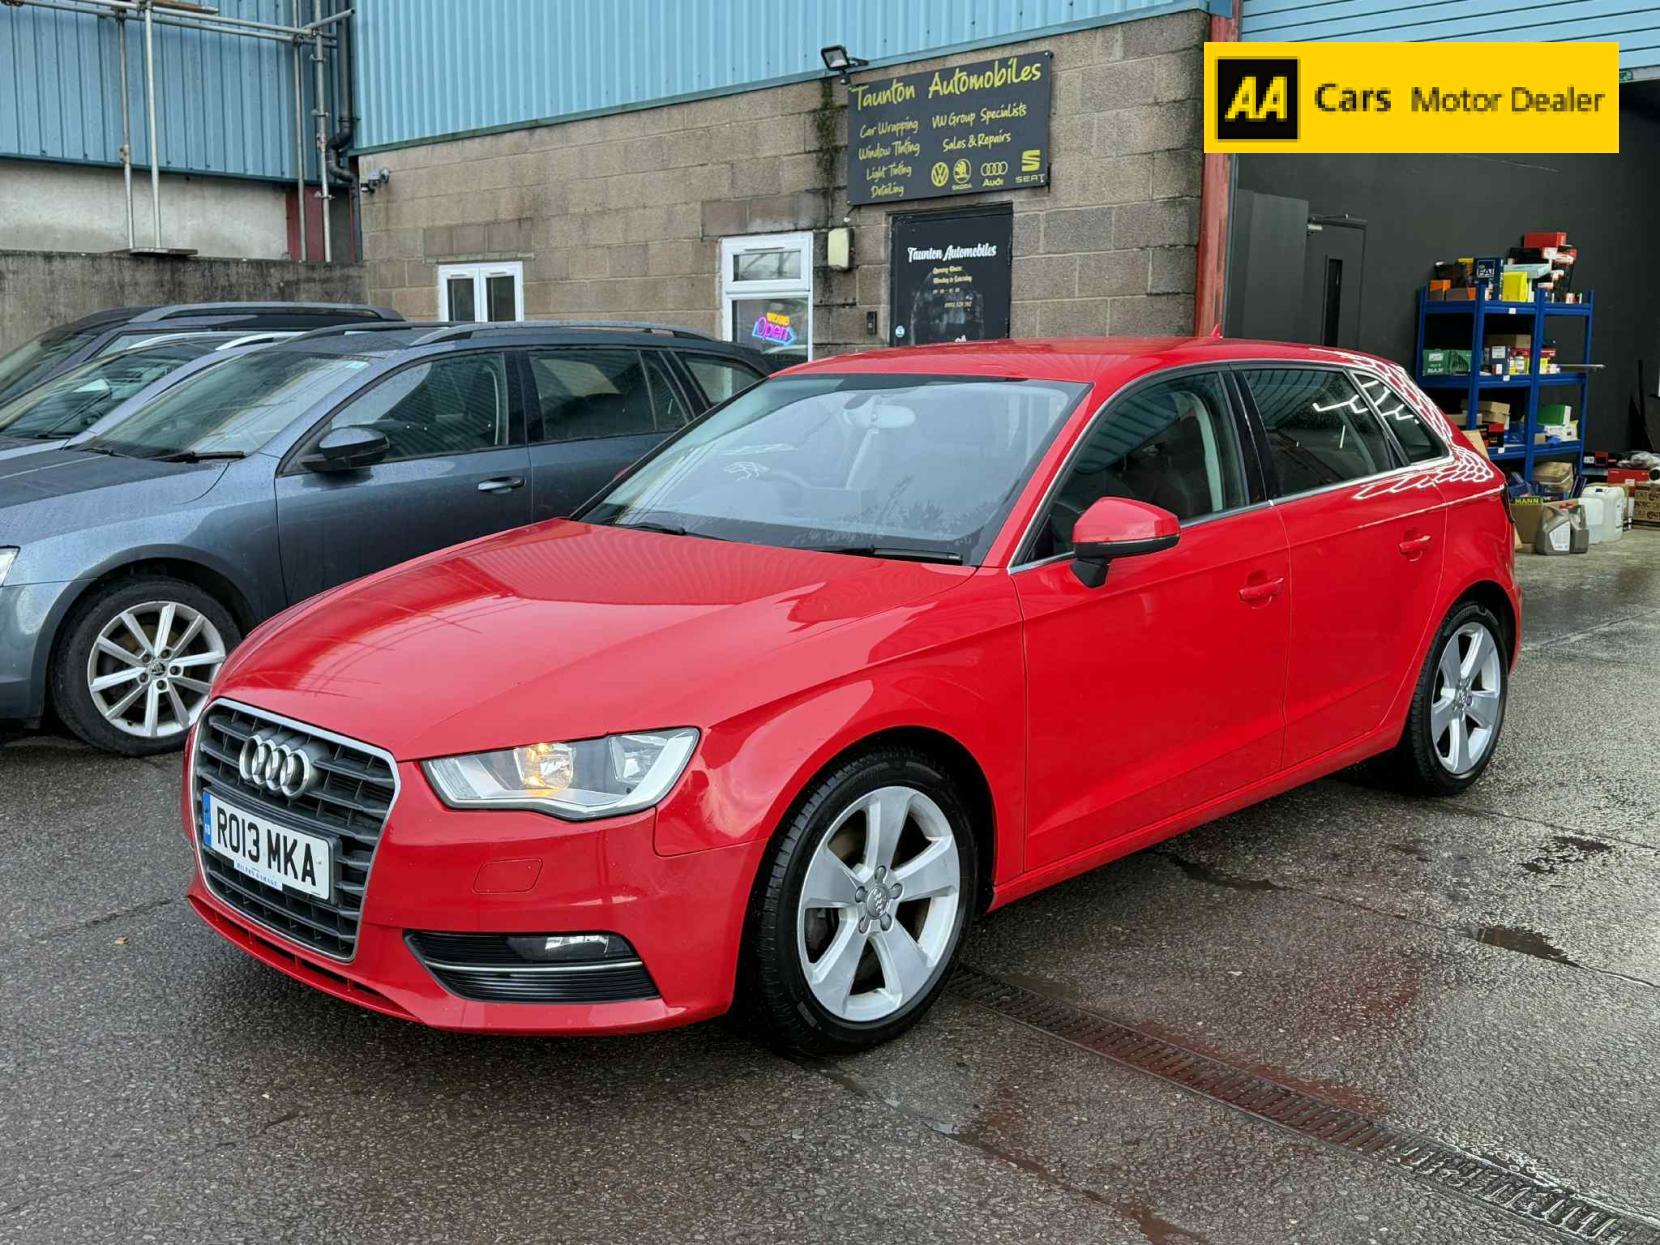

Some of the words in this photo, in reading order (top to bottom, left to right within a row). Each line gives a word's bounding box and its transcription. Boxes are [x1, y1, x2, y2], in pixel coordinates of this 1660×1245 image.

[849, 78, 916, 111] Taunton
[928, 57, 1042, 98] Automobiles
[948, 112, 976, 127] Group
[980, 102, 1028, 125] Specialists
[860, 124, 877, 138] Car
[878, 116, 919, 136] Wrapping
[859, 142, 891, 160] Window
[891, 136, 920, 157] Tinting
[943, 136, 966, 152] Sales
[967, 134, 977, 148] &
[978, 129, 1012, 149] Repairs
[867, 165, 887, 182] Light
[887, 160, 912, 177] Tinting
[982, 177, 1004, 187] Audi
[1015, 173, 1046, 184] SEAT
[907, 246, 942, 263] Taunton
[942, 242, 998, 262] Automobiles
[756, 316, 788, 341] Open
[217, 806, 260, 864] RO13
[267, 828, 317, 887] MKA
